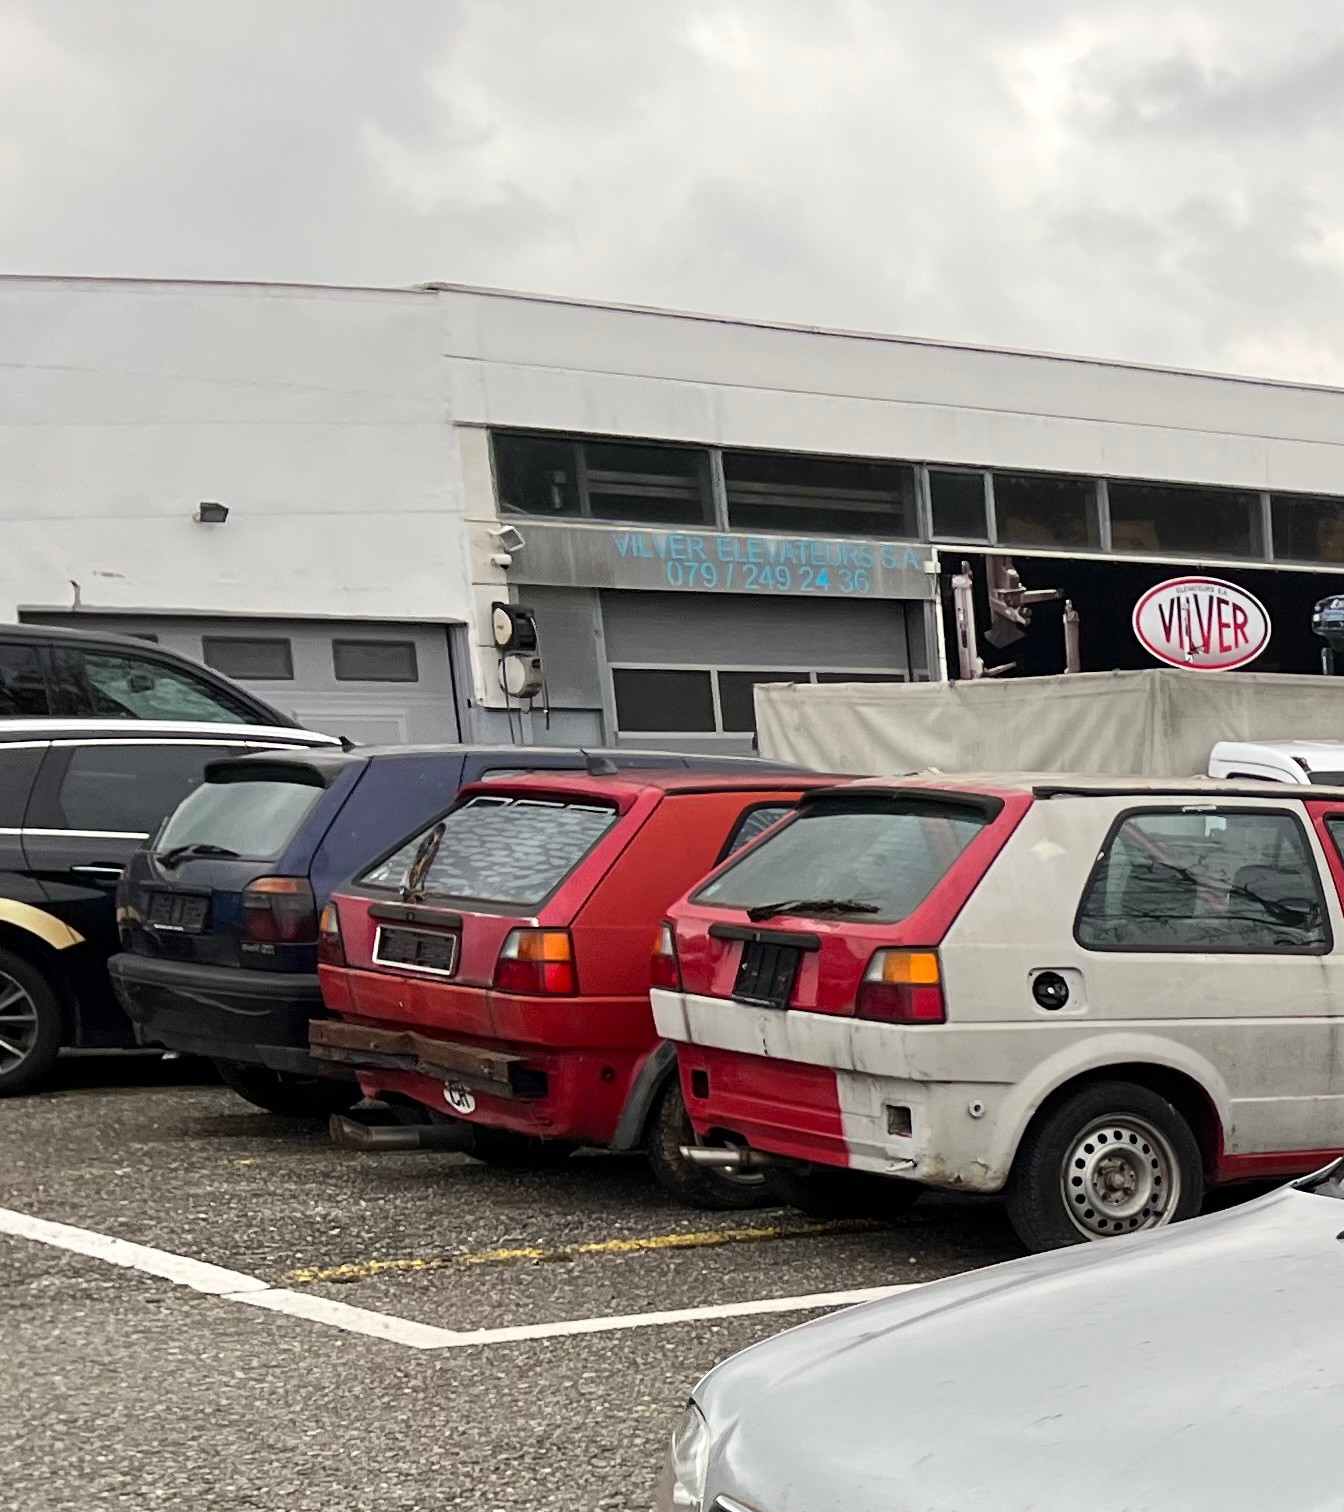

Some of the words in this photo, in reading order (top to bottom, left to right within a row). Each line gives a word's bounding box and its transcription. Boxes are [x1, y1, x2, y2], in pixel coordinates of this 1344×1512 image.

[612, 532, 705, 561] VILVER
[717, 536, 875, 569] ELEVATEURS
[666, 561, 718, 588] 079
[743, 564, 791, 591] 249
[801, 567, 830, 591] 24
[839, 570, 870, 593] 36
[1158, 592, 1249, 655] VILVER
